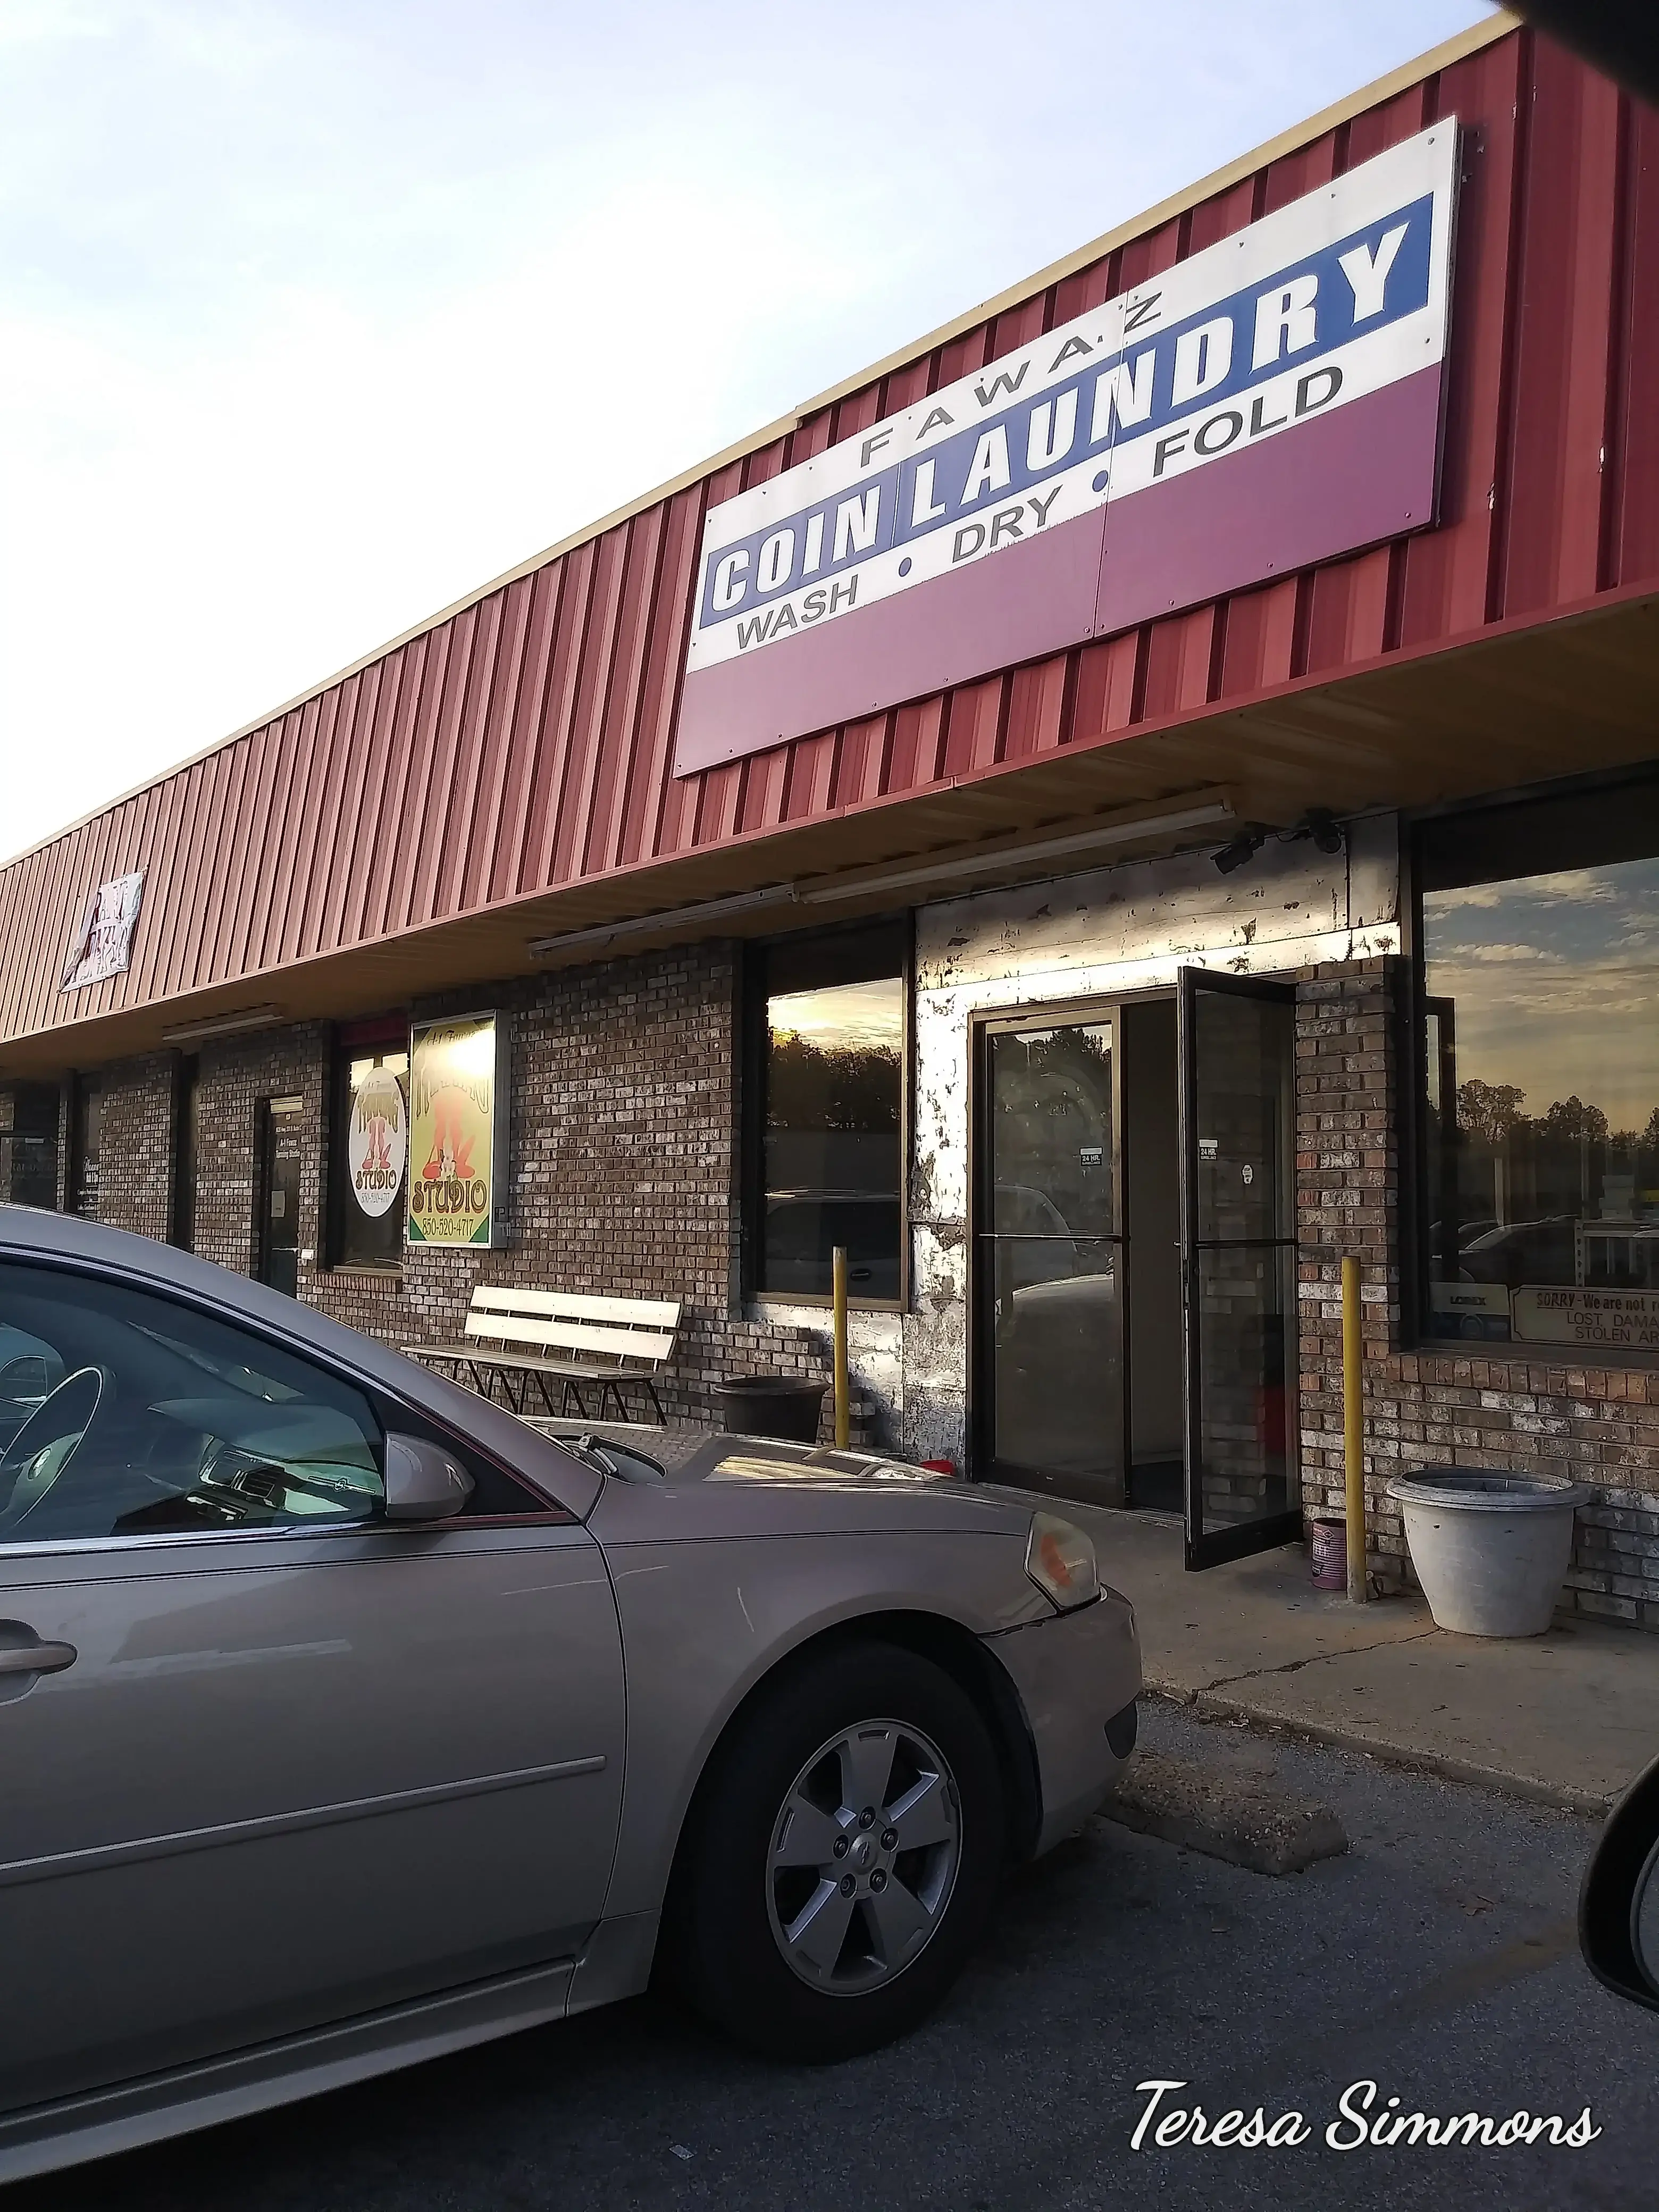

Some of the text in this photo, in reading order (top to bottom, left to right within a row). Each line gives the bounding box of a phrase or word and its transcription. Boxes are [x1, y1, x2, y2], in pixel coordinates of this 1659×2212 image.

[712, 222, 1410, 612] COIN LAUNDRY
[737, 366, 1343, 650] WASH DRY FOLD
[355, 1169, 397, 1190] STUDIO
[412, 1179, 487, 1214] STUDIO
[422, 1217, 474, 1236] 850-520-4717
[1537, 1293, 1574, 1309] SORRY
[1583, 1293, 1600, 1309] We
[1603, 1298, 1622, 1310] are
[1626, 1297, 1645, 1311] not
[1576, 1326, 1630, 1342] STOLEN
